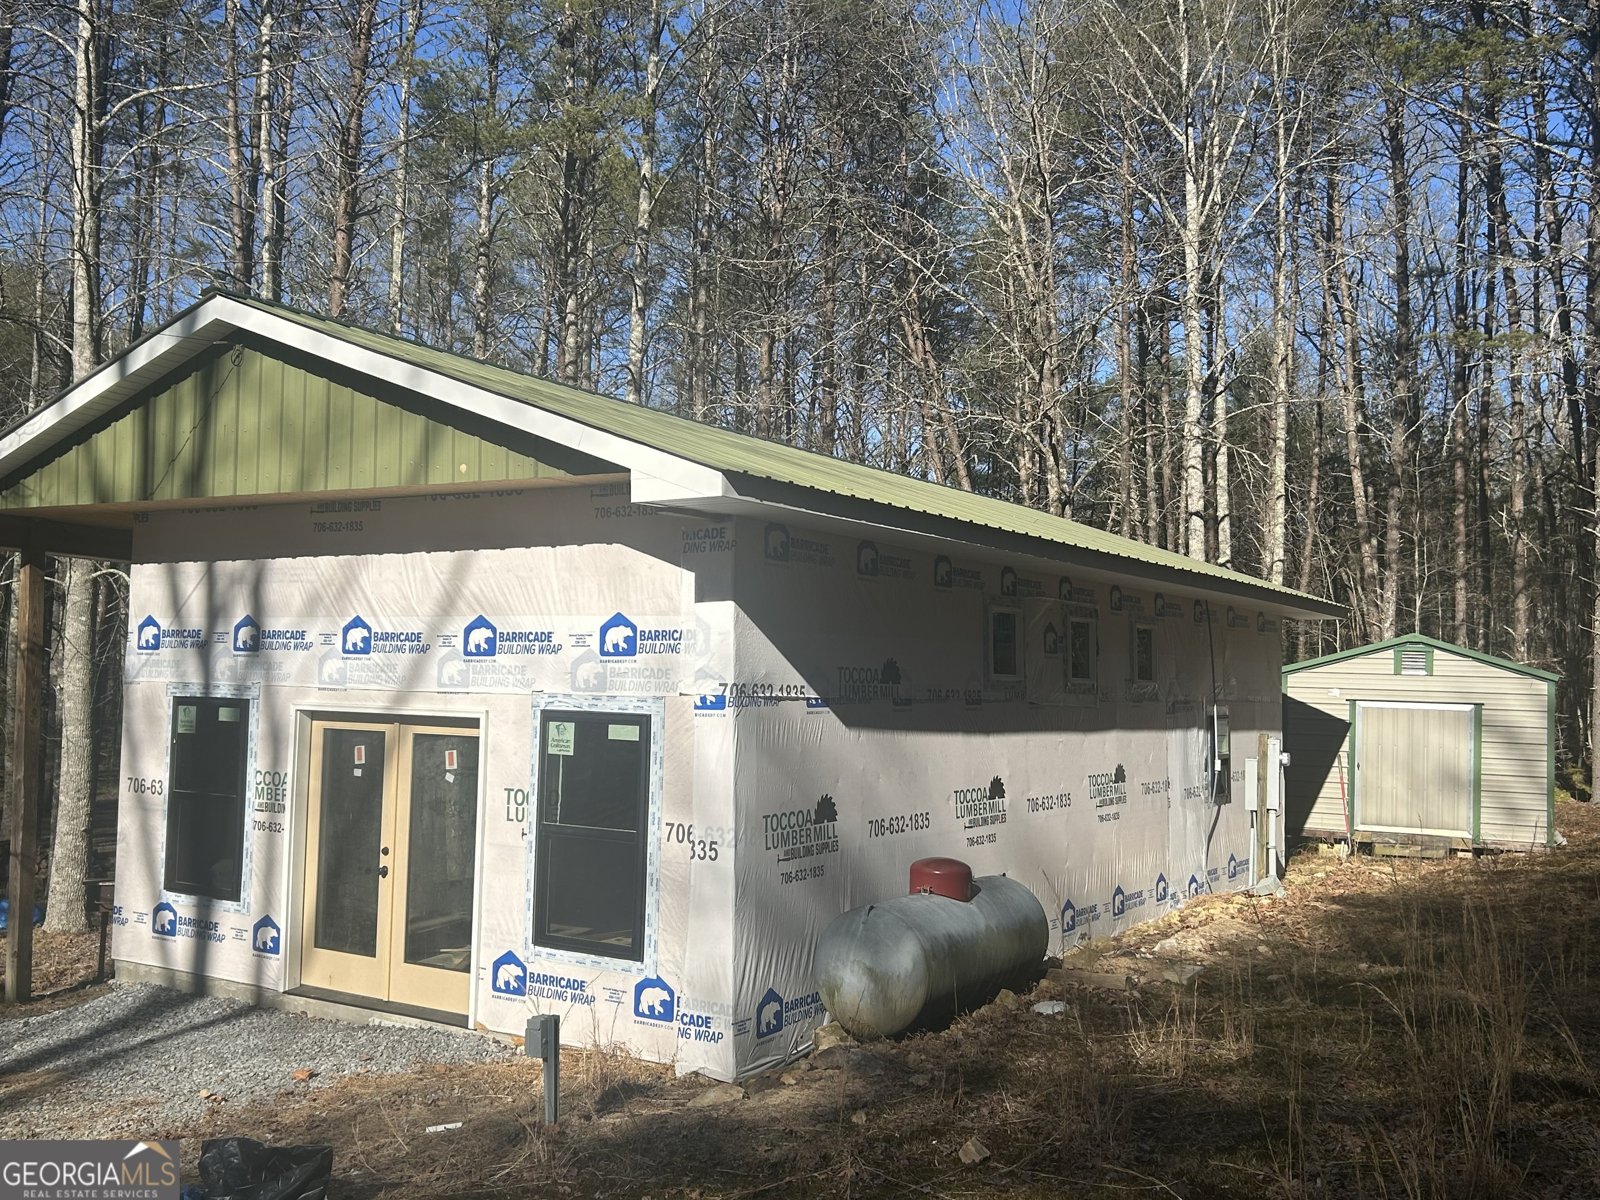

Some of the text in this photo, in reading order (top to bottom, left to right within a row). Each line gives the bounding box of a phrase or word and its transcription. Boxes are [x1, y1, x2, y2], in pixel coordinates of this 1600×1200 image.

[161, 629, 203, 639] BARRICADE
[261, 630, 307, 641] BARRICADE
[373, 632, 423, 643] BARRICADE
[498, 631, 554, 643] BARRICADE
[160, 639, 209, 650] BUILDING WRAP
[260, 640, 314, 652] BUILDING WRAP
[372, 643, 431, 655] BUILDING WRAP
[497, 643, 563, 655] BUILDING WRAP
[638, 643, 681, 654] BUILDING
[837, 666, 880, 684] TOCCOA
[127, 777, 163, 796] 706-63
[1088, 773, 1114, 788] TOCCOA
[953, 787, 988, 805] TOCCOA
[1026, 792, 1072, 814] 706-632-1835
[762, 808, 813, 834] TOCCOA
[868, 811, 931, 839] 706-632-1835
[966, 832, 997, 848] 706-632-1835
[790, 839, 839, 861] BUILDING SUPPLIES
[780, 864, 825, 885] 706-632-1835
[178, 916, 220, 932] BARRICADE
[177, 928, 206, 940] BUILDING
[206, 930, 226, 944] WRAP
[528, 971, 587, 992] BARRICADE
[527, 984, 568, 1002] BUILDING
[570, 991, 596, 1006] WRAP
[680, 1012, 712, 1030] CADE
[784, 1005, 813, 1027] BUILDING
[694, 1030, 724, 1044] WRAP
